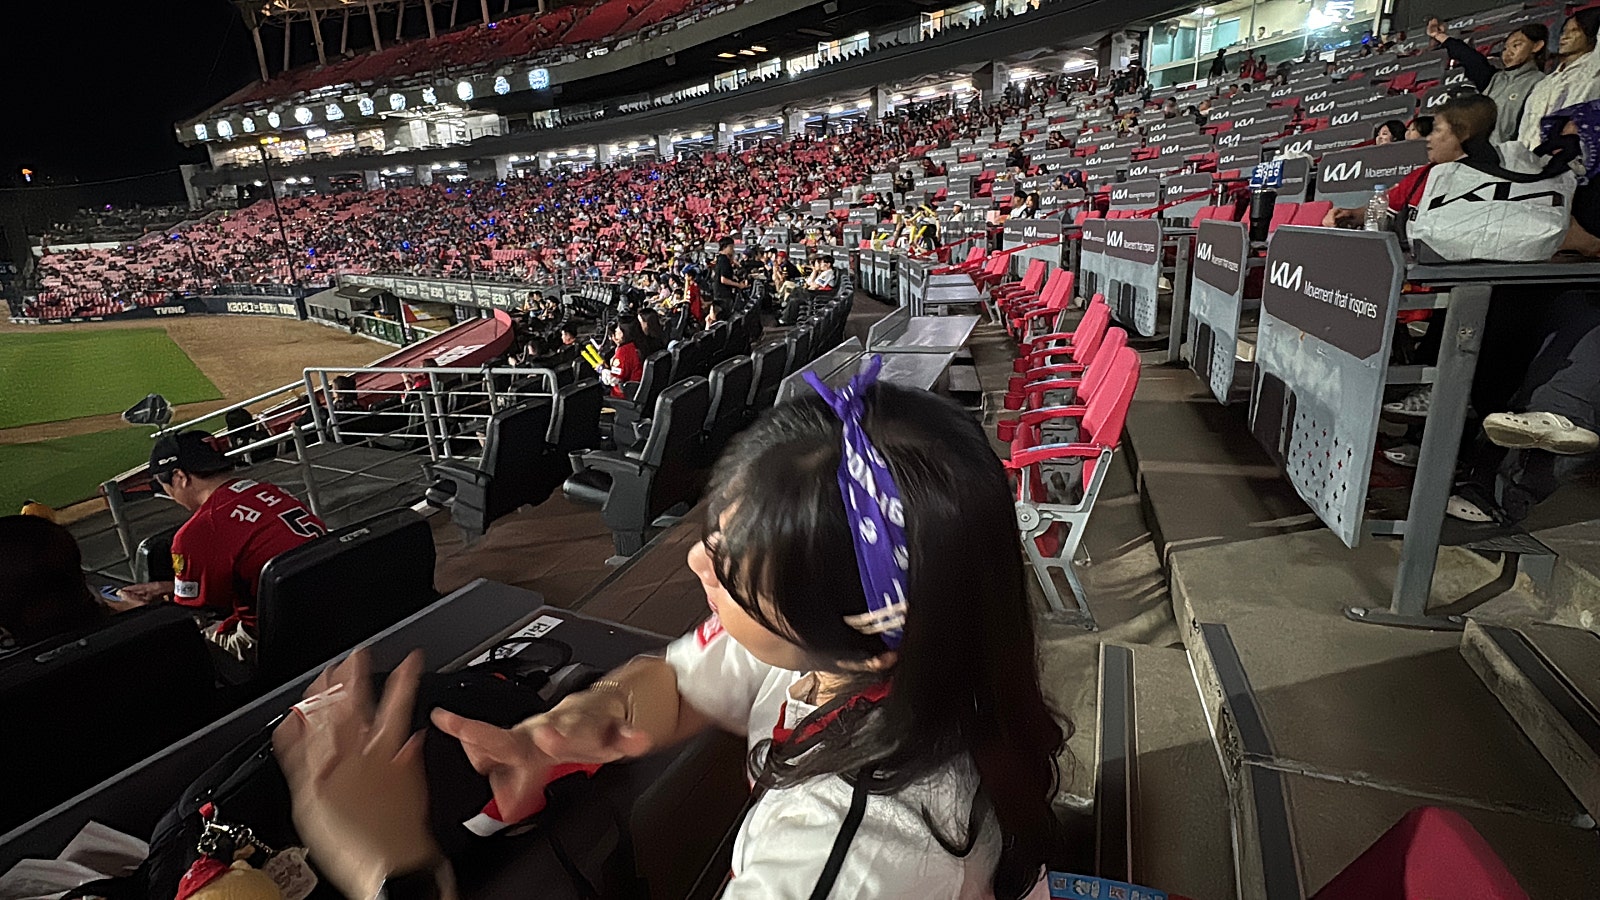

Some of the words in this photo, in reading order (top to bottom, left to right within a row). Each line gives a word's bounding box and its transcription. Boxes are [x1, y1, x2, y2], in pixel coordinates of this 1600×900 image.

[154, 305, 185, 315] TVING
[1304, 280, 1334, 304] Movement
[1334, 289, 1349, 308] that
[1348, 293, 1378, 319] inspires
